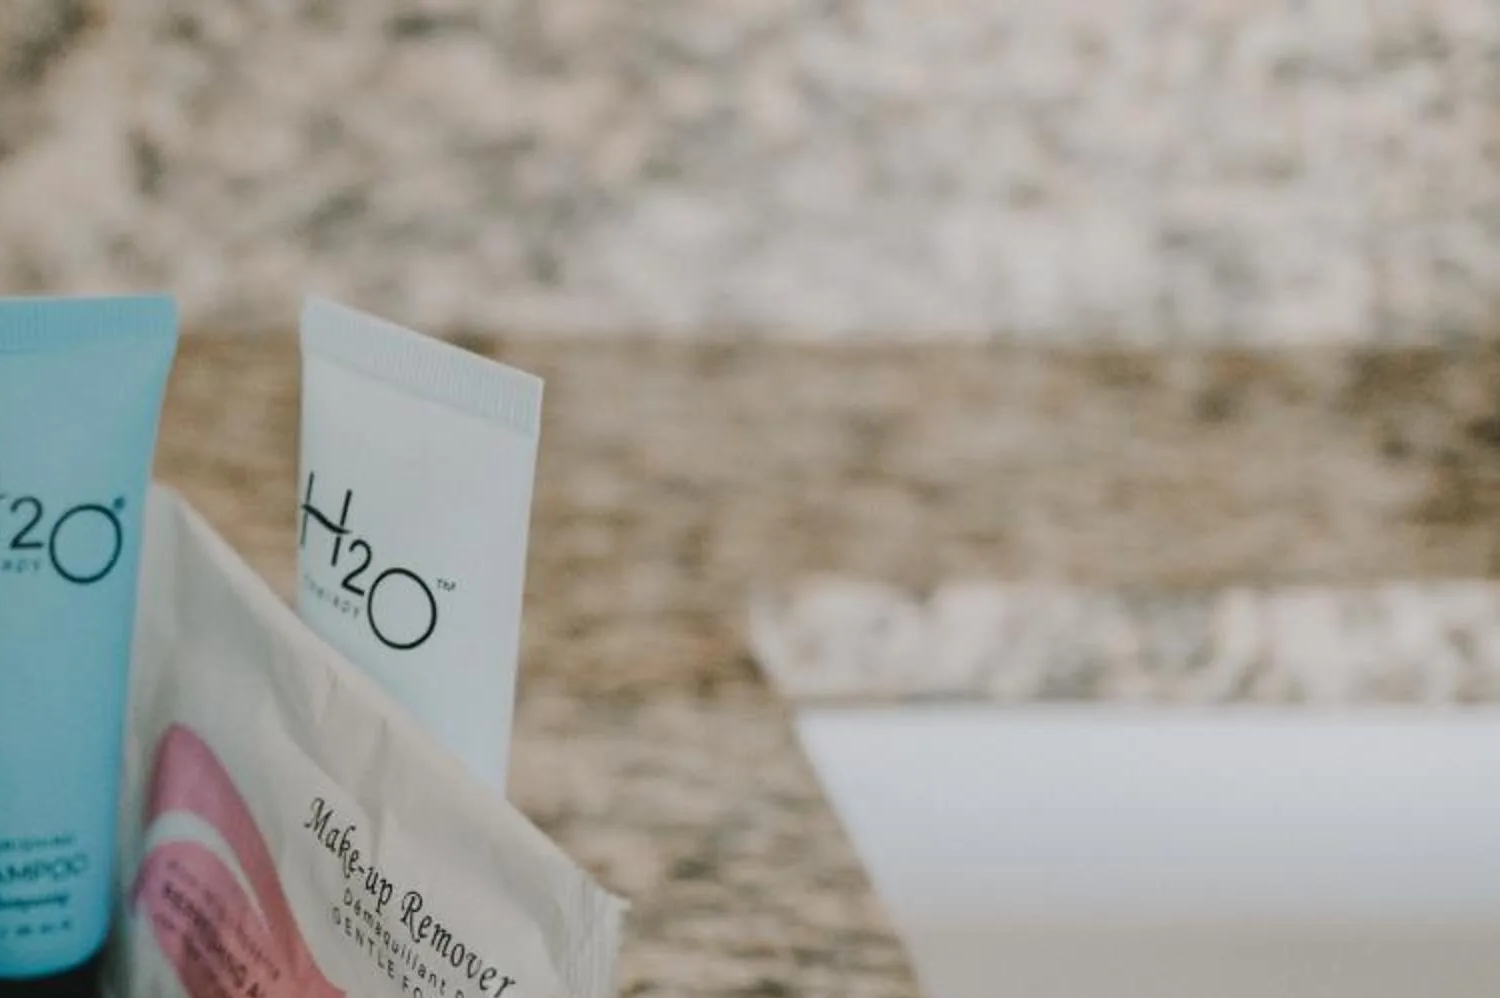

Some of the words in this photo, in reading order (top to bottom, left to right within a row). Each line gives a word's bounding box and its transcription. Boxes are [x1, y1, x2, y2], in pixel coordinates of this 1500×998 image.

[304, 797, 394, 916] Make-up
[400, 891, 516, 998] Remover
[332, 906, 395, 980] GENTLE
